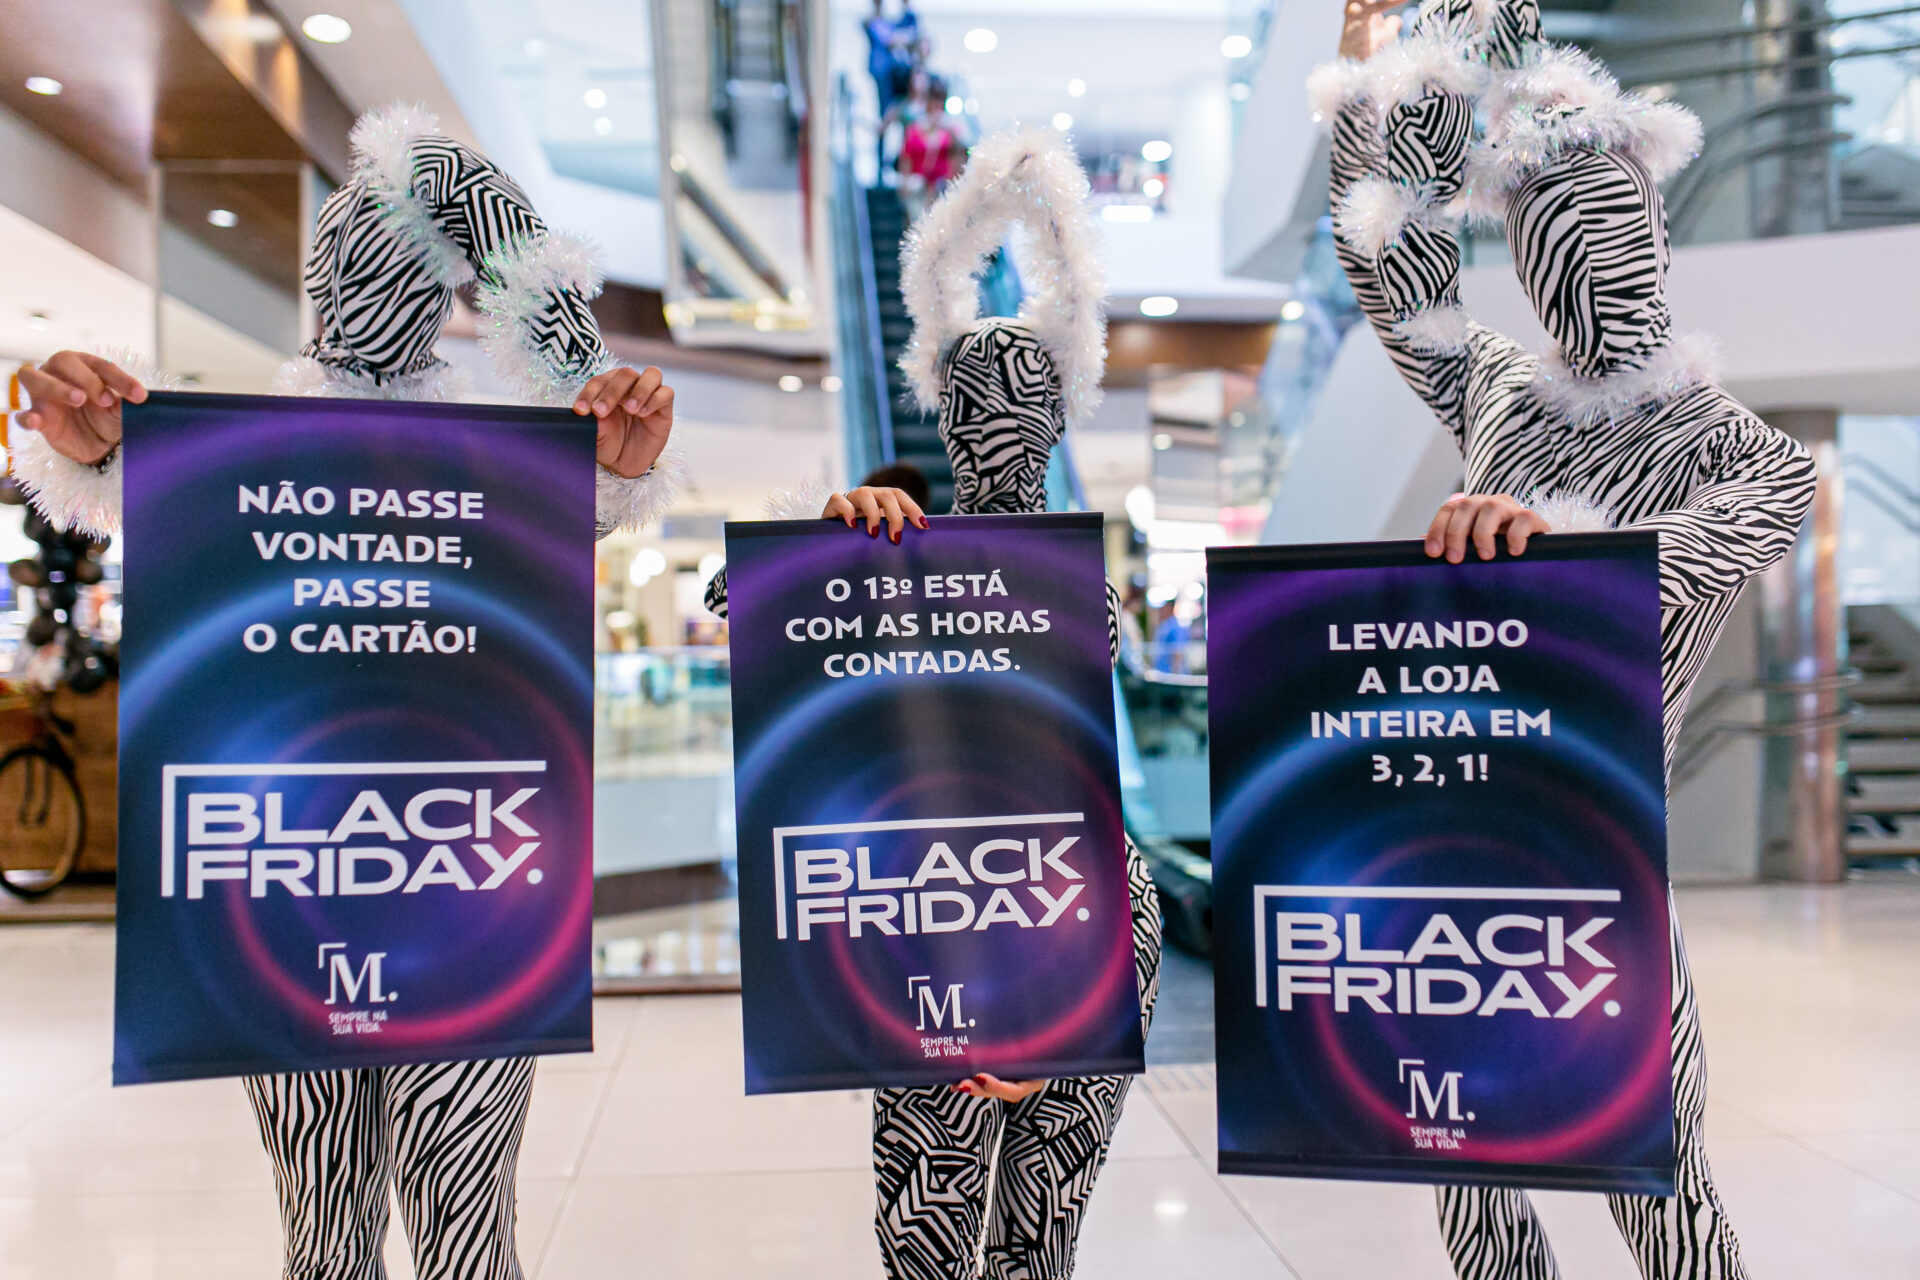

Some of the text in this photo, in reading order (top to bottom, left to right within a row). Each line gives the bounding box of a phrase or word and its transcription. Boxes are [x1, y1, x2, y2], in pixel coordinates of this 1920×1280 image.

[239, 481, 483, 519] NÃO PASSE
[252, 532, 472, 569] VONTADE,
[294, 579, 430, 607] PASSE
[826, 579, 851, 601] O
[925, 569, 1008, 598] ESTÁ
[244, 620, 476, 653] O CARTÃO!
[786, 610, 1050, 641] COM AS HORAS
[1329, 620, 1528, 650] LEVANDO
[824, 648, 1020, 677] CONTADAS.
[1358, 665, 1500, 693] A LOJA
[1312, 709, 1550, 738] INTEIRA EM
[1373, 754, 1487, 786] 3, 2, 1!
[188, 788, 540, 844] BLACK
[188, 842, 543, 899] FRIDAY.
[795, 837, 1084, 893] BLACK
[797, 884, 1089, 940] FRIDAY.
[1277, 912, 1615, 967] BLACK
[1278, 966, 1620, 1018] FRIDAY.
[328, 1010, 388, 1024] SEMPRE NA
[332, 1024, 353, 1035] SUA
[920, 1035, 969, 1049] SEMPRE NA
[924, 1045, 966, 1058] SUA VIDA.
[1410, 1126, 1466, 1140] SEMPRE NA
[1414, 1138, 1433, 1149] SUA
